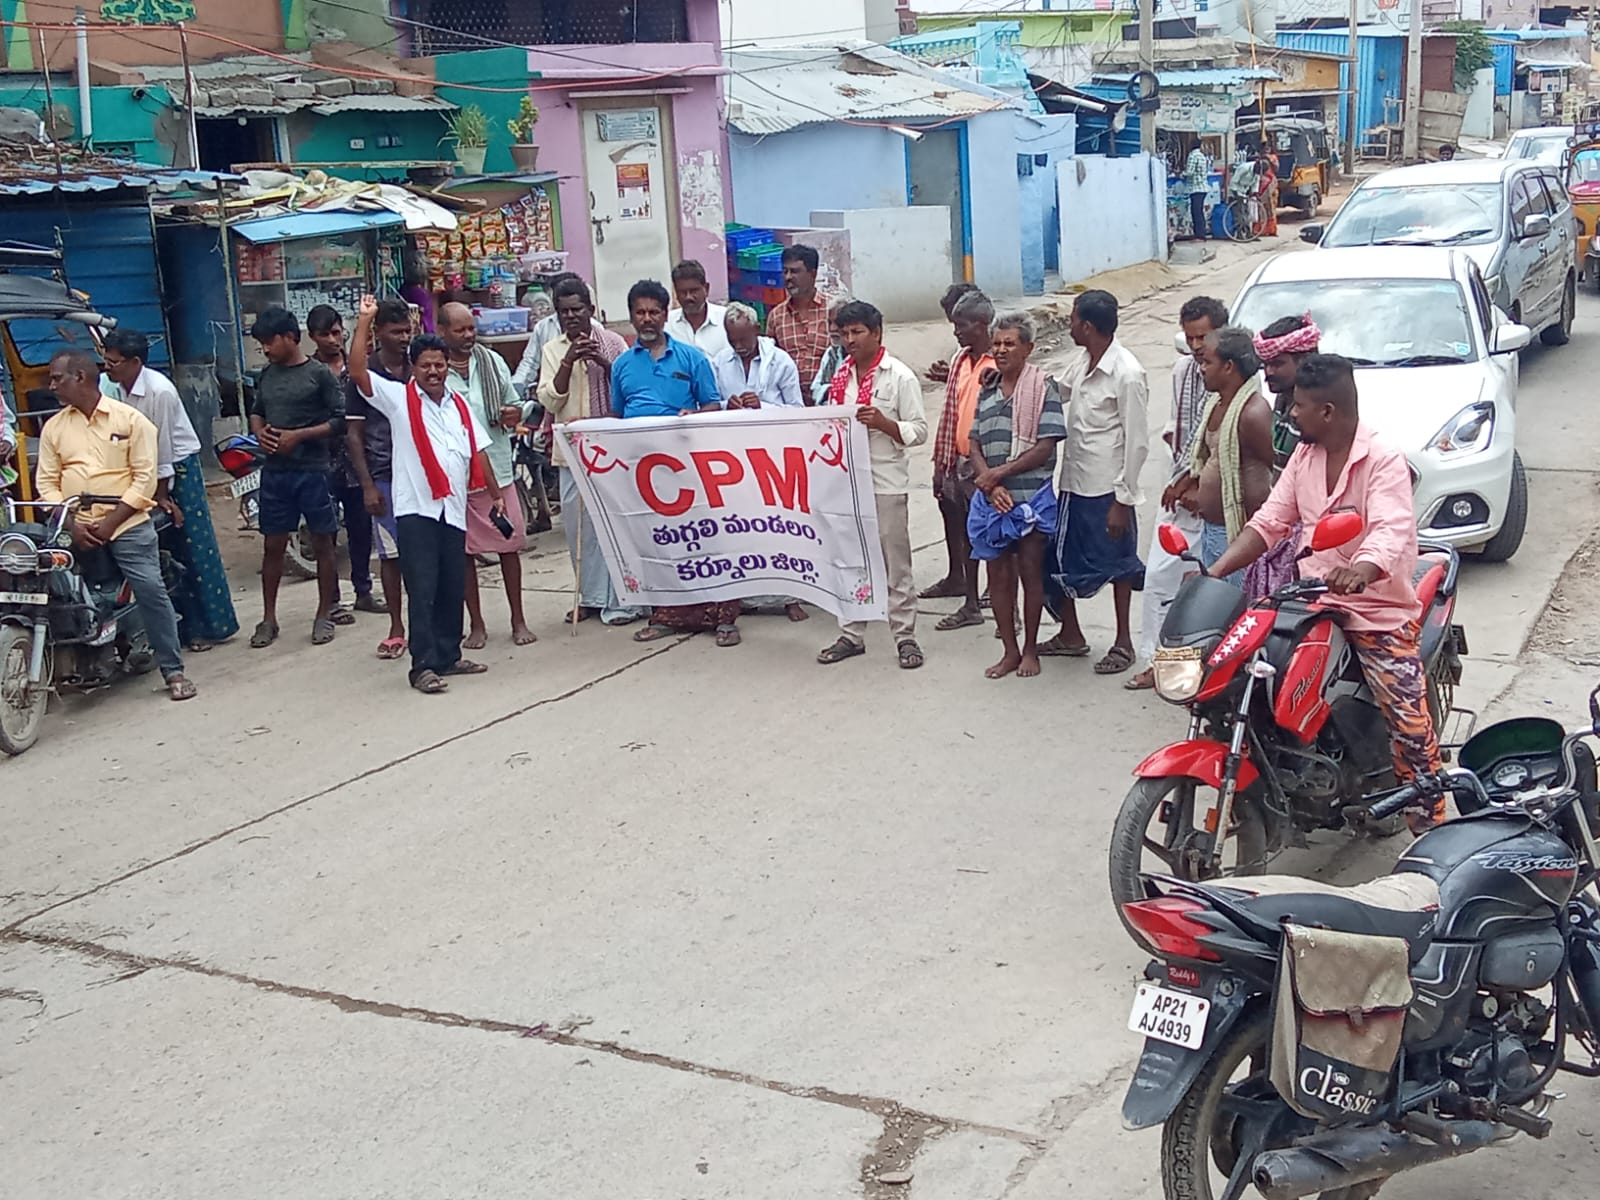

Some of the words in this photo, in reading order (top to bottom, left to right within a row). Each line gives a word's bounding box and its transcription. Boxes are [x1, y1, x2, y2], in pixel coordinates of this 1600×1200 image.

[635, 447, 811, 517] CPM
[652, 518, 719, 552] తుగ్గలి
[676, 553, 767, 581] కర్నూలు
[1479, 851, 1578, 873] Passion
[1152, 994, 1188, 1019] AP21
[1300, 1064, 1377, 1115] Classic
